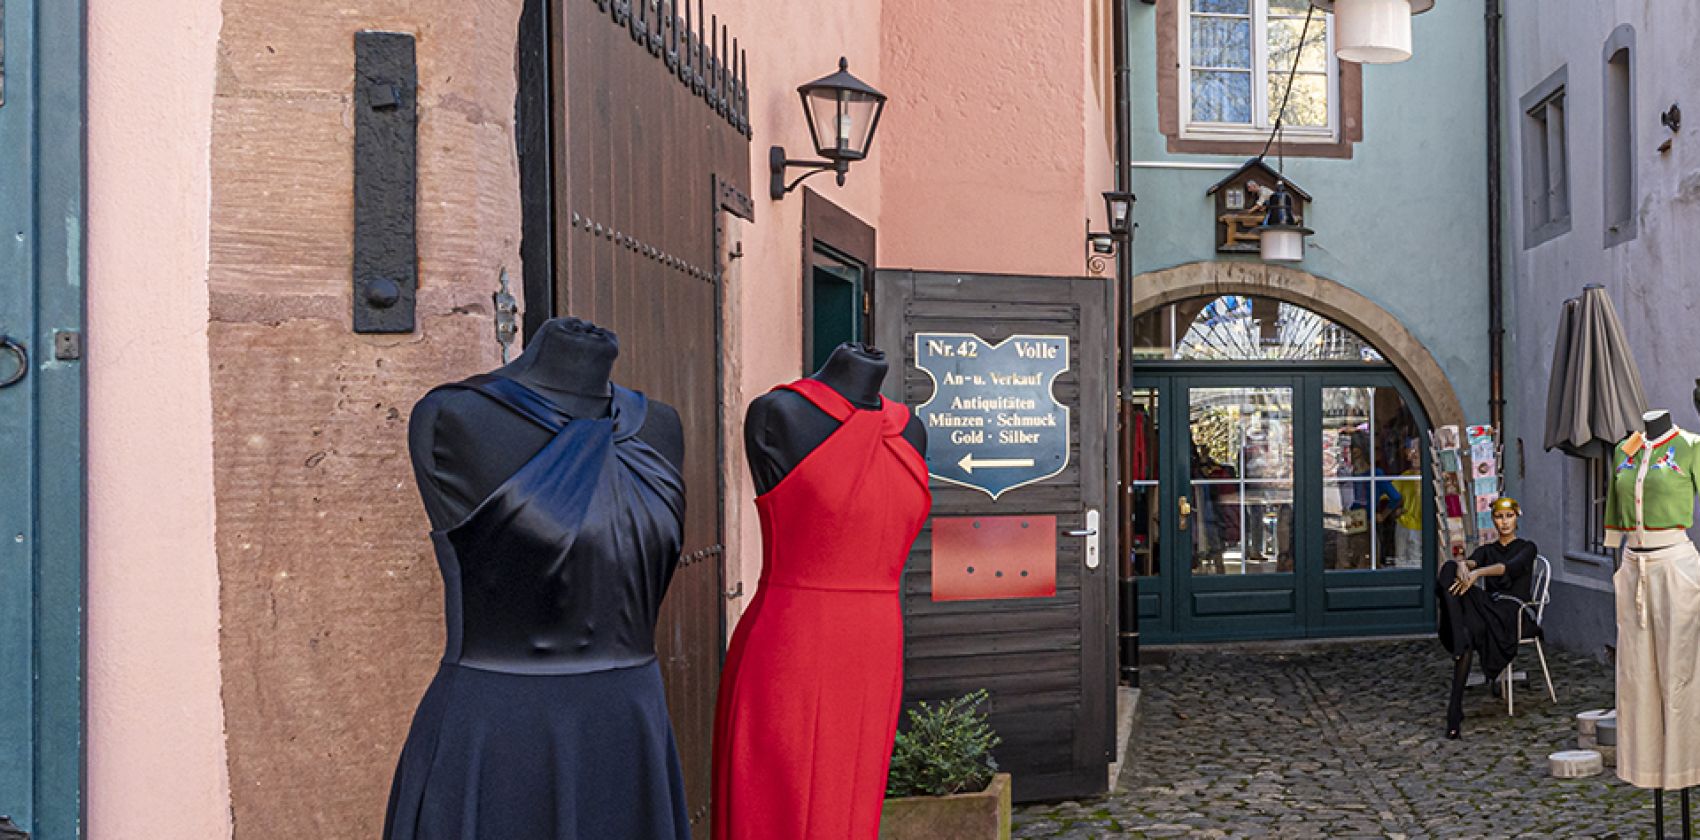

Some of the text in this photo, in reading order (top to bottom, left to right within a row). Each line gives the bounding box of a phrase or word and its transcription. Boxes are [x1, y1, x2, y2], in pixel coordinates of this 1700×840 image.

[1014, 341, 1058, 359] Volle
[989, 371, 1044, 386] Verkauf
[951, 396, 1035, 412] Antiquitäten
[929, 412, 1057, 427] Münzen Schmuck
[951, 430, 1040, 444] Gold Silber
